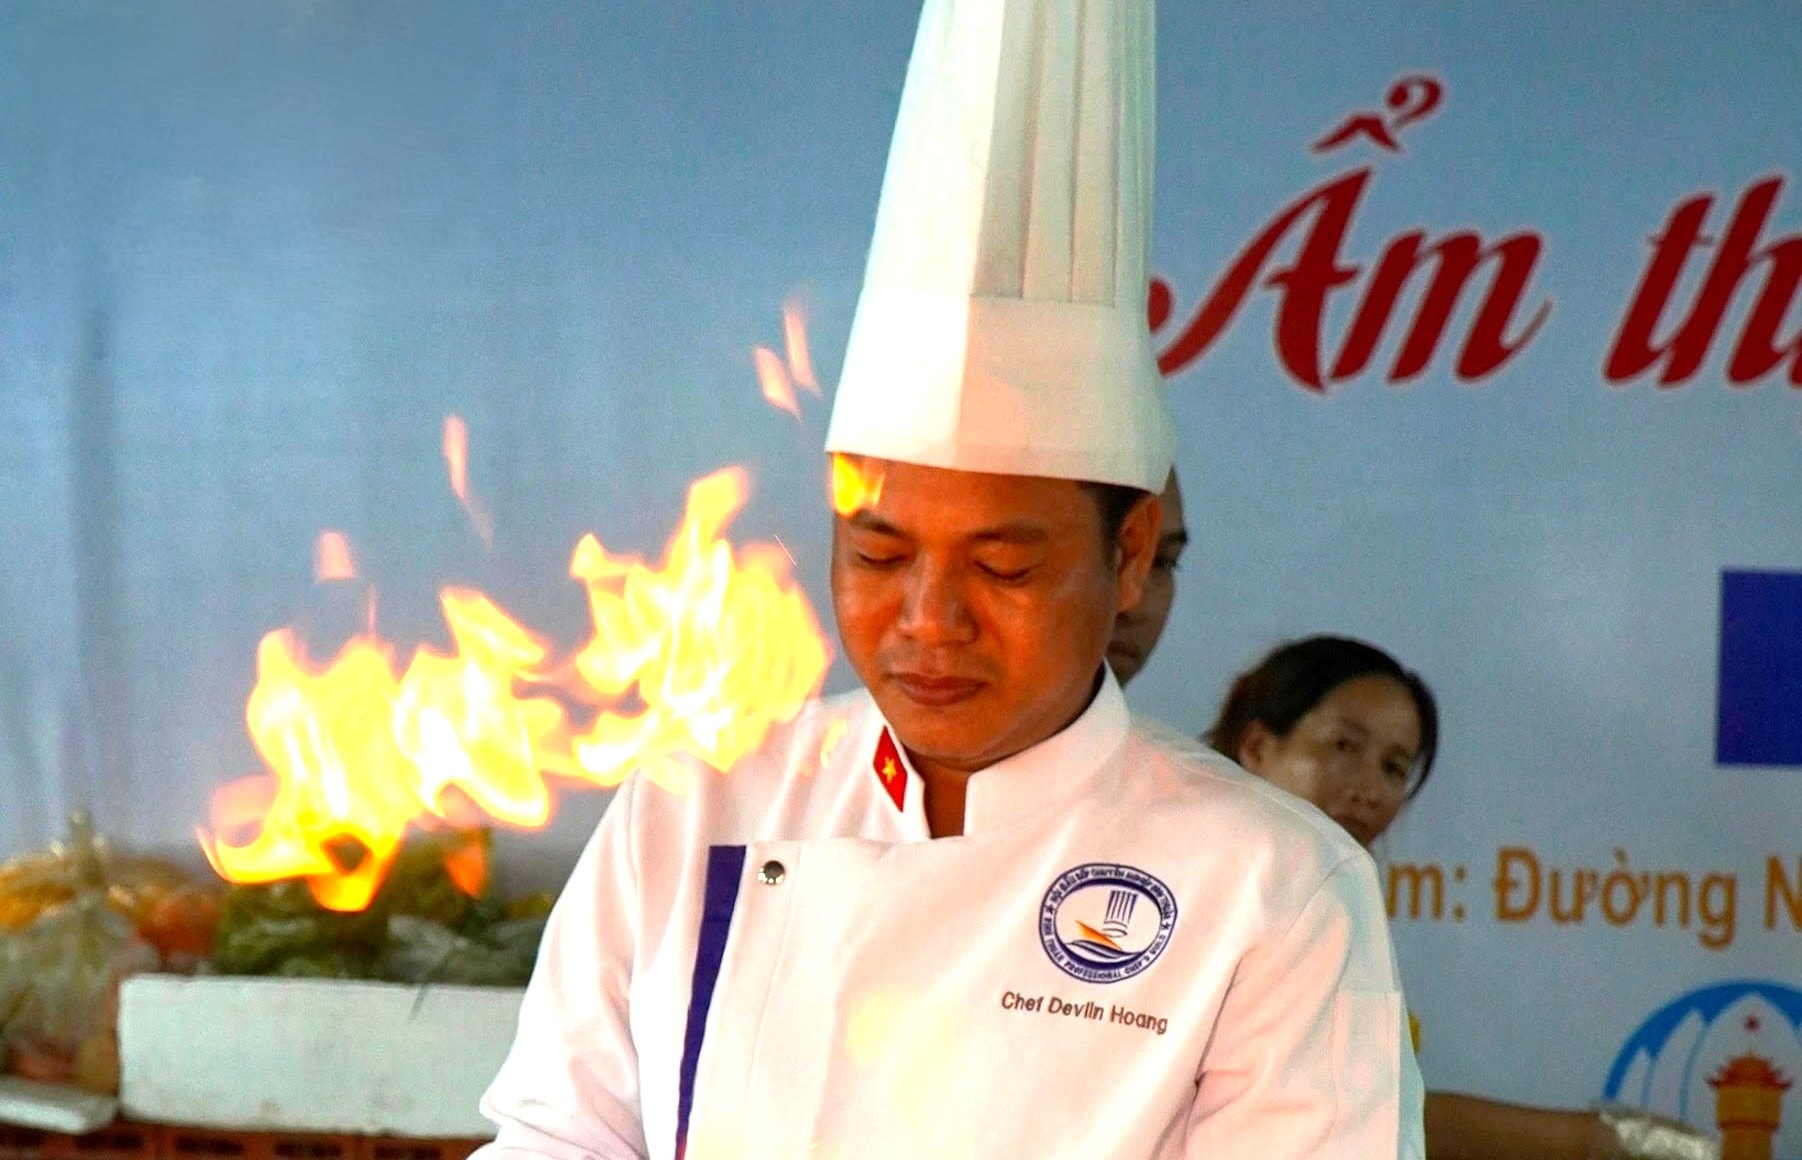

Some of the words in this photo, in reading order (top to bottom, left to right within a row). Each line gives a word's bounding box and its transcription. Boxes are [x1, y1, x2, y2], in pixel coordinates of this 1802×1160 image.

[1147, 75, 1554, 395] Ẩm
[1603, 173, 1802, 388] th
[1492, 845, 1738, 951] Đường
[1001, 991, 1044, 1012] Chef
[1110, 1005, 1169, 1036] Hoang
